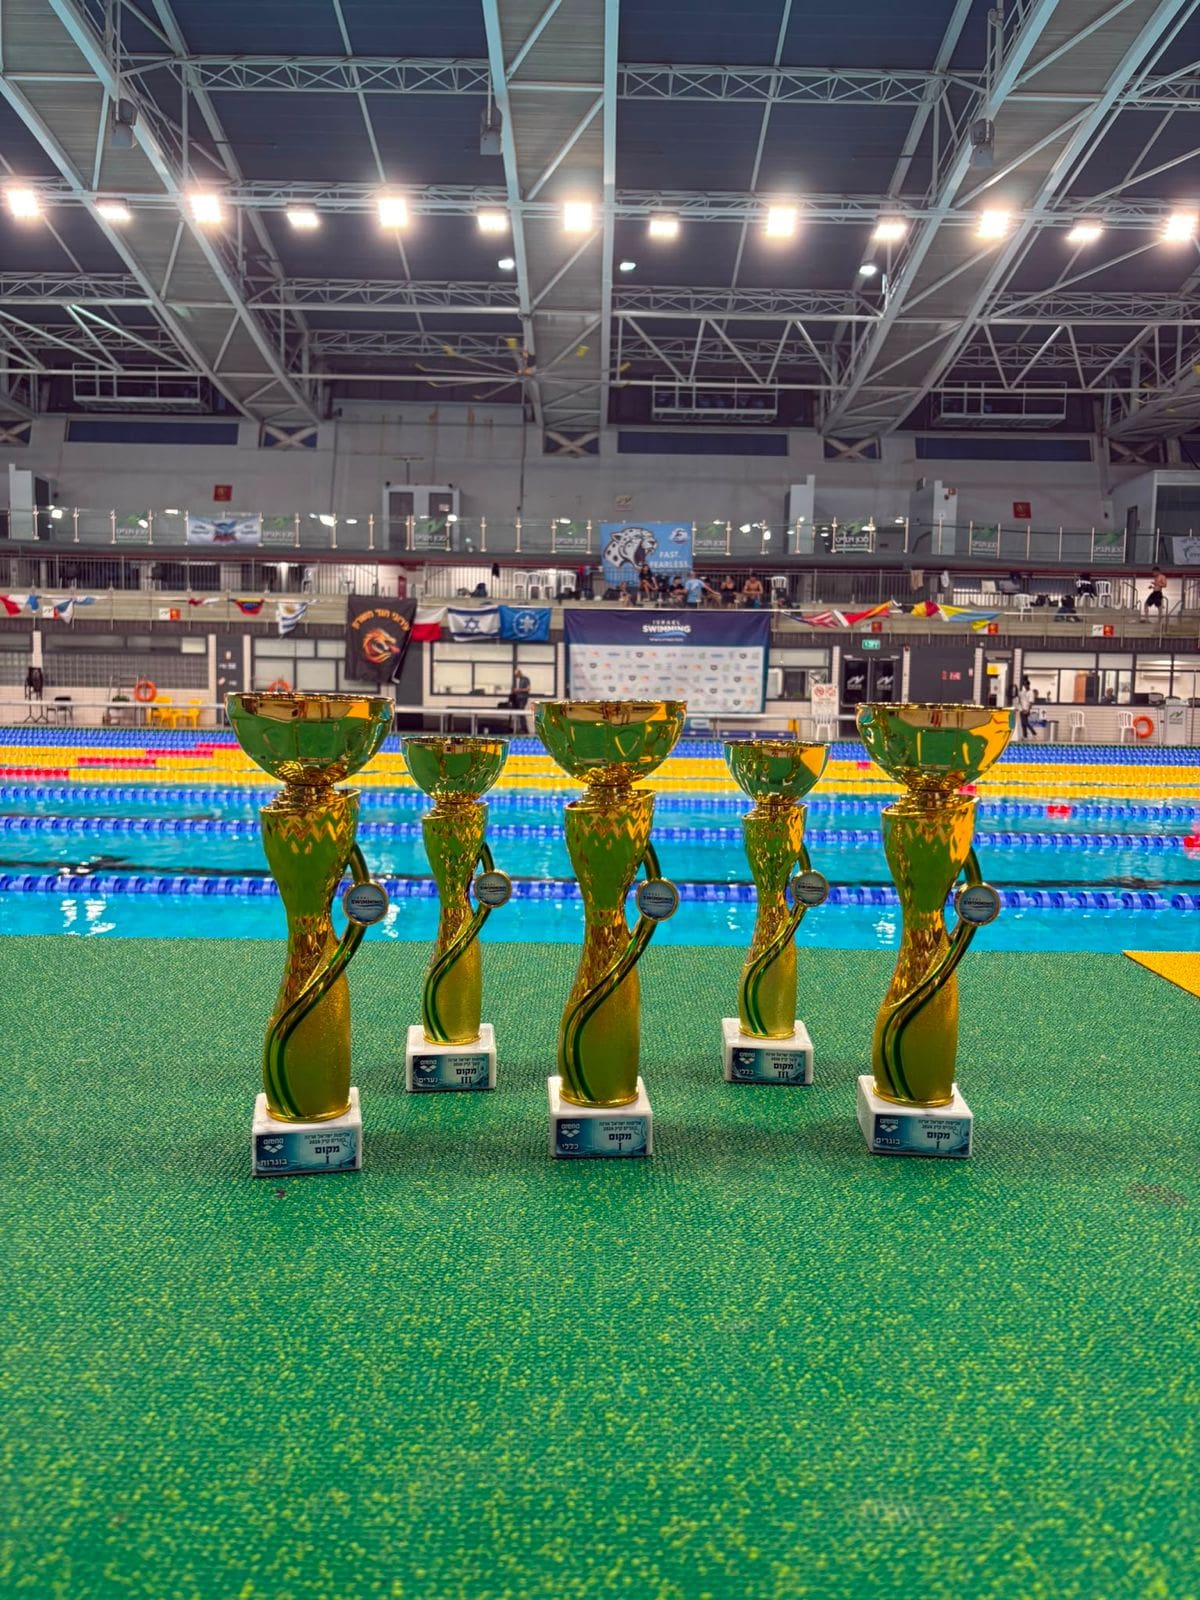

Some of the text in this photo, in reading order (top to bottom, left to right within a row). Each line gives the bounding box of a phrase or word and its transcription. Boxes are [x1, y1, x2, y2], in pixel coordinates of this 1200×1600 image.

[642, 625, 691, 633] SWIMMING
[609, 1133, 631, 1141] מקום
[927, 1131, 950, 1139] מקום
[315, 1145, 340, 1154] מקום
[260, 1158, 287, 1166] בוגרות
